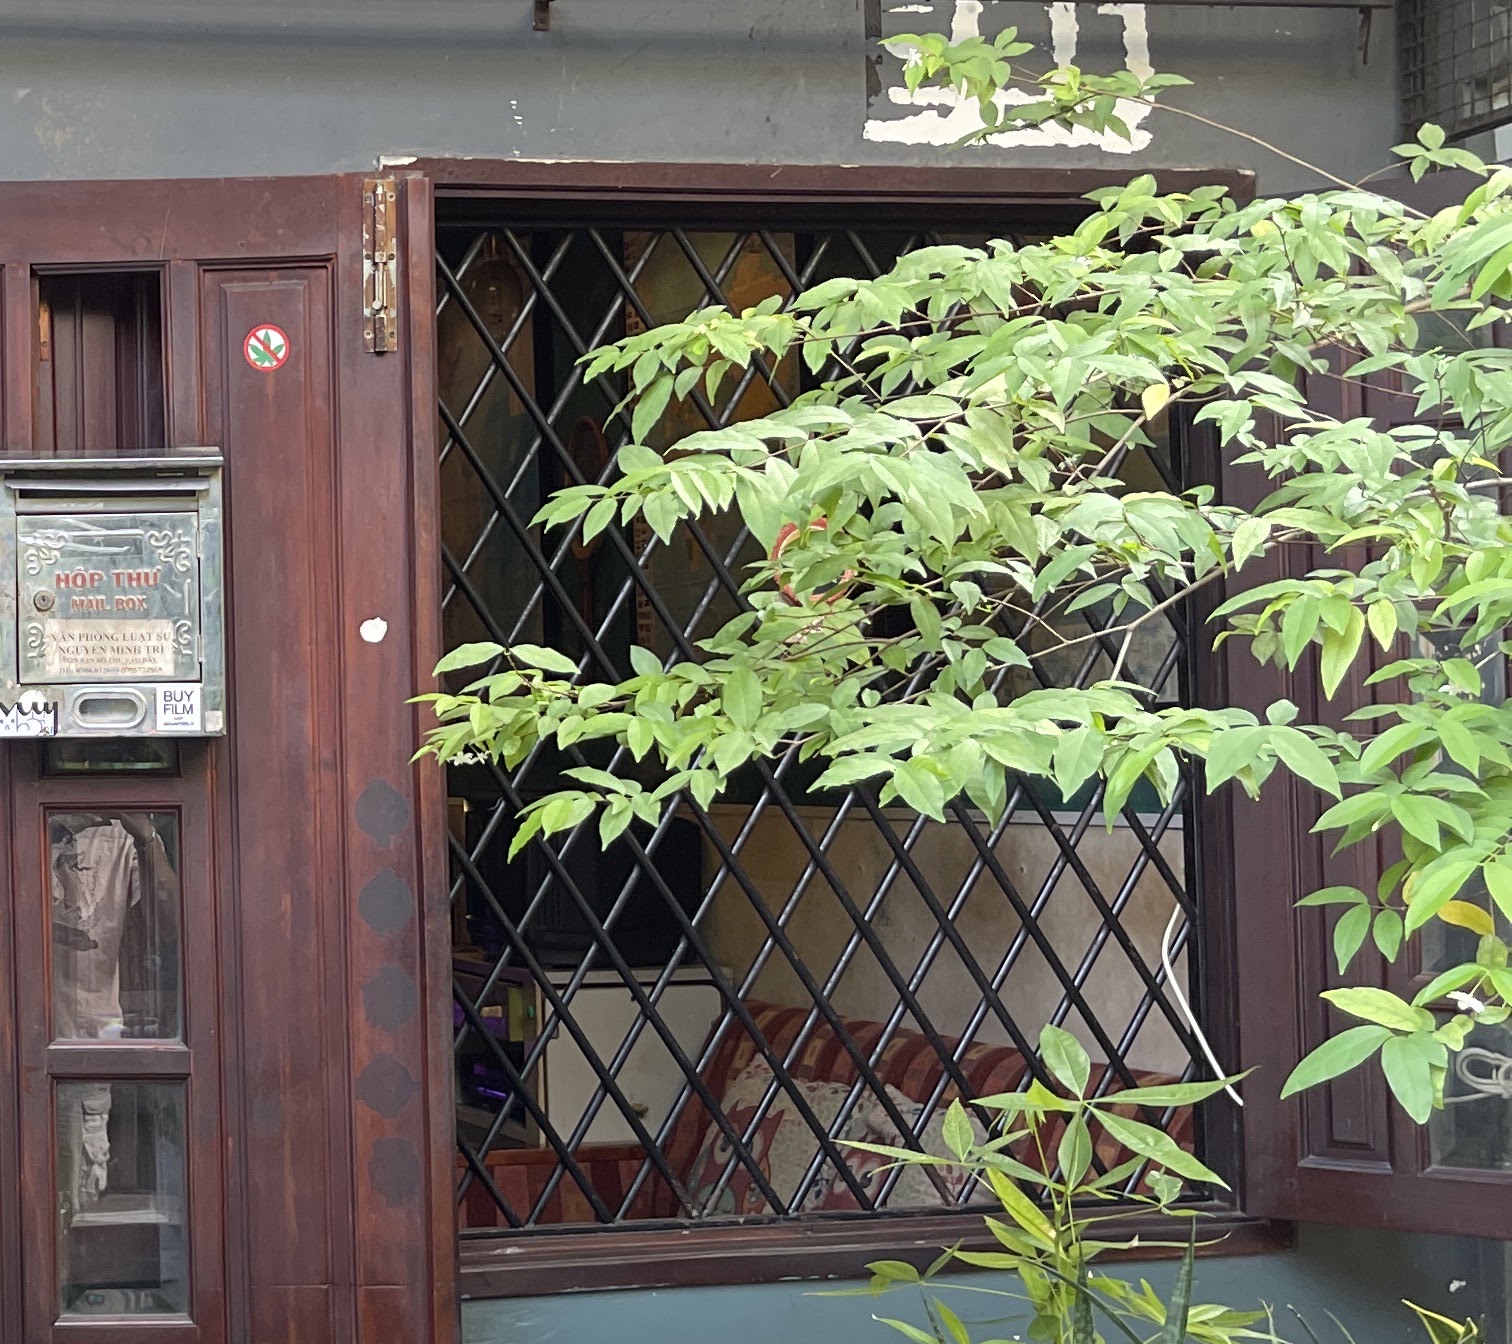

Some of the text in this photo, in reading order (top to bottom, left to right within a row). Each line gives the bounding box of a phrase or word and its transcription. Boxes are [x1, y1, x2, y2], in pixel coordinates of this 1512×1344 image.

[110, 565, 162, 589] THƯ
[71, 595, 147, 611] MAIL BOX
[110, 645, 142, 655] MINH
[163, 690, 194, 702] BUY
[163, 703, 194, 715] FILM
